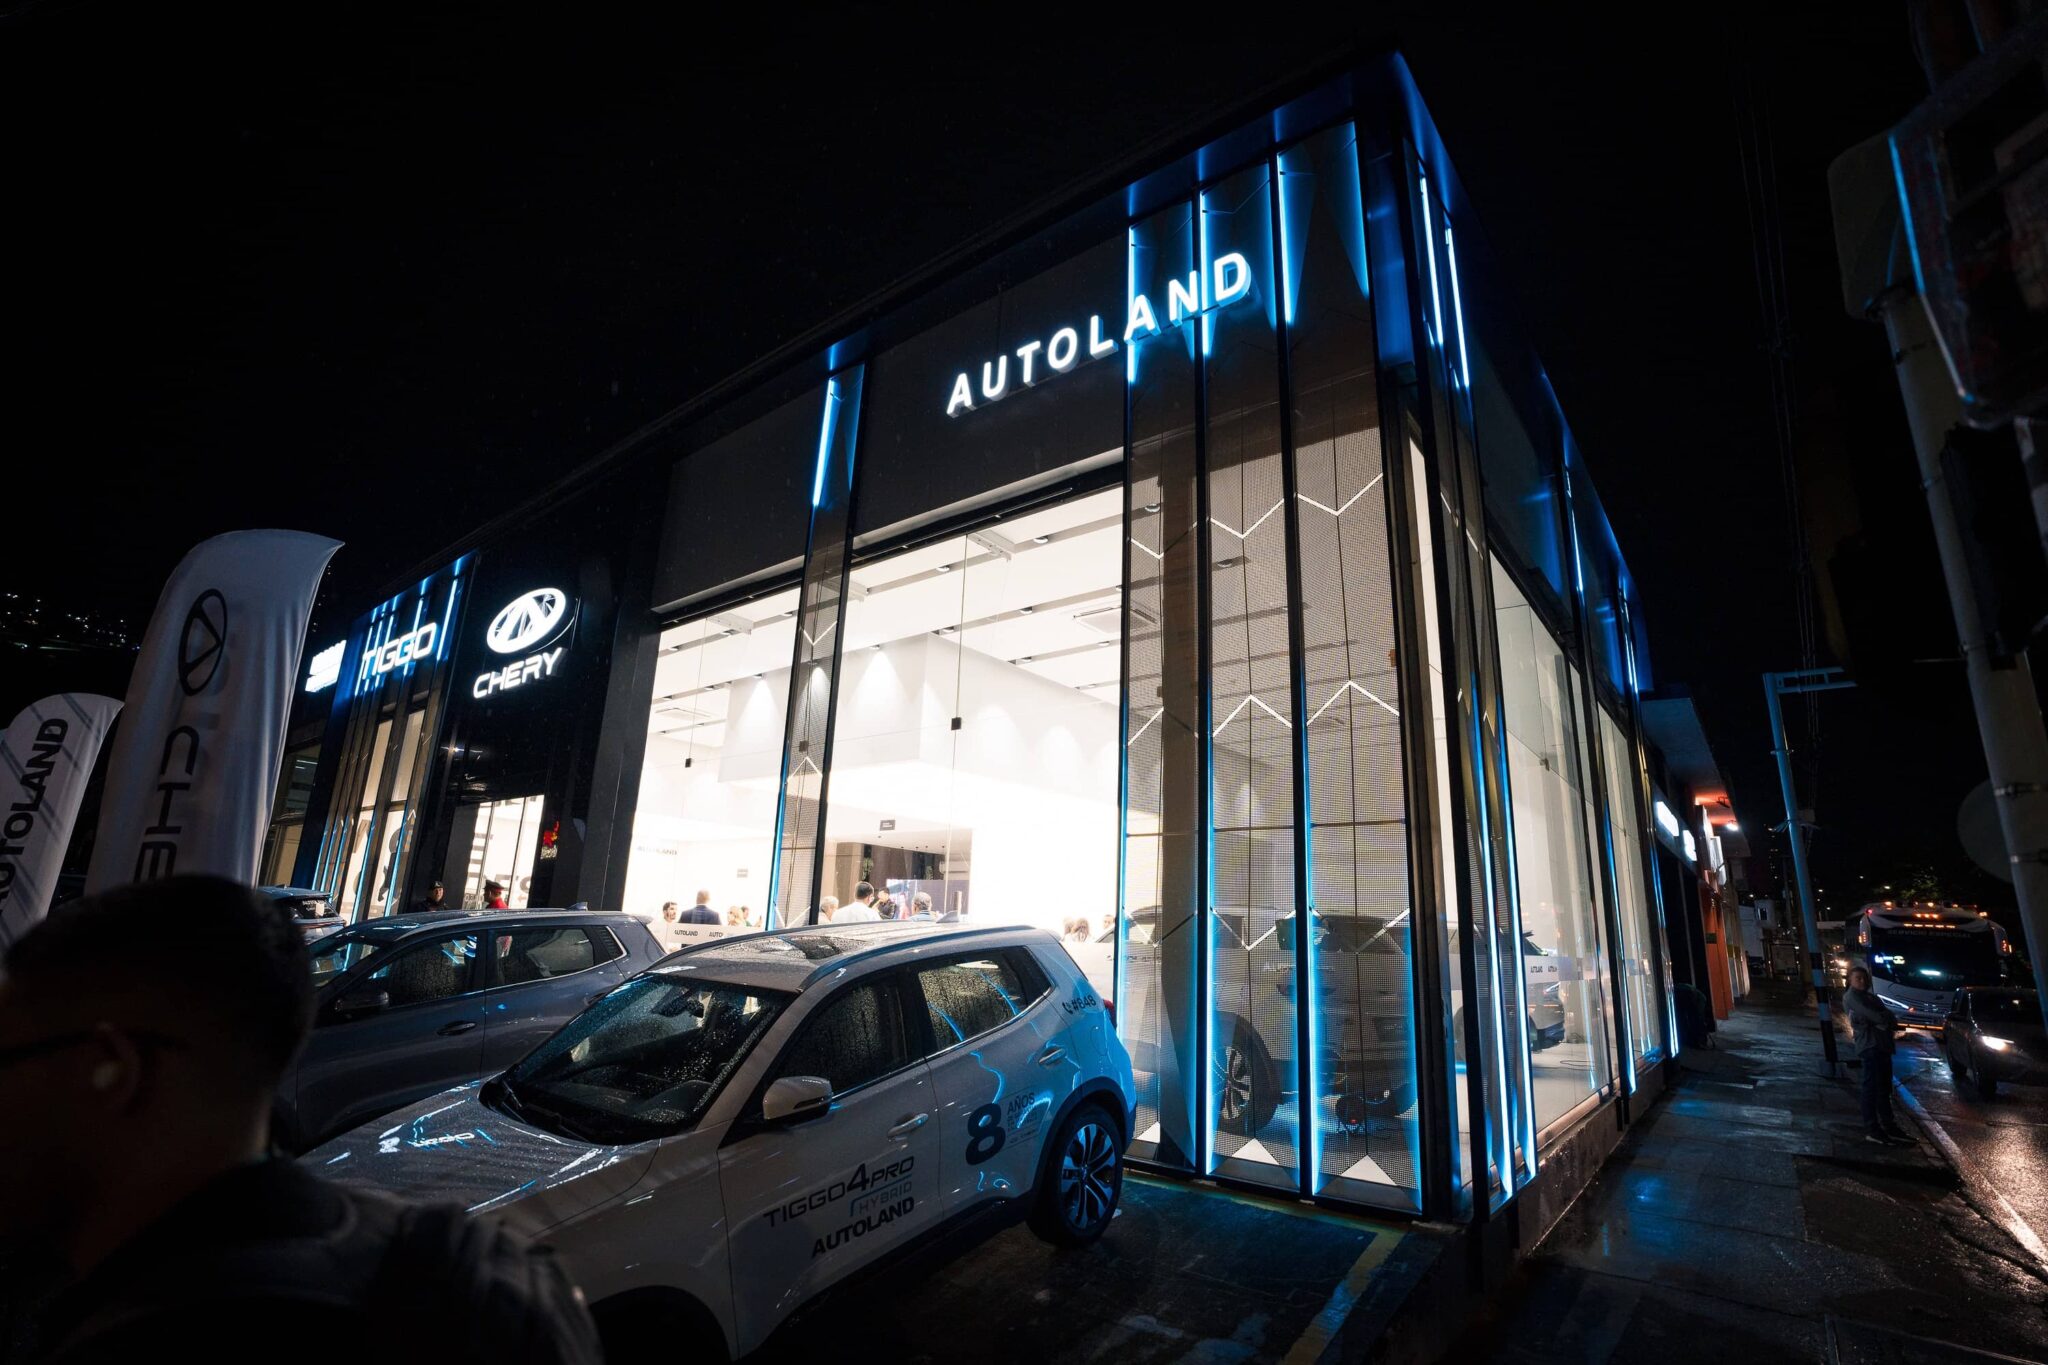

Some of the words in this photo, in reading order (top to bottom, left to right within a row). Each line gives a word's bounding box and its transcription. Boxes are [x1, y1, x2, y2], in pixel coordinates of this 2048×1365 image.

[946, 252, 1251, 417] AUTOLAND
[362, 622, 437, 679] TIGGO
[473, 647, 565, 698] CHERY
[965, 1103, 1006, 1166] 8
[1007, 1091, 1035, 1114] AÑOS
[811, 1196, 915, 1258] AUTOLAND
[859, 1181, 913, 1214] HYBRID
